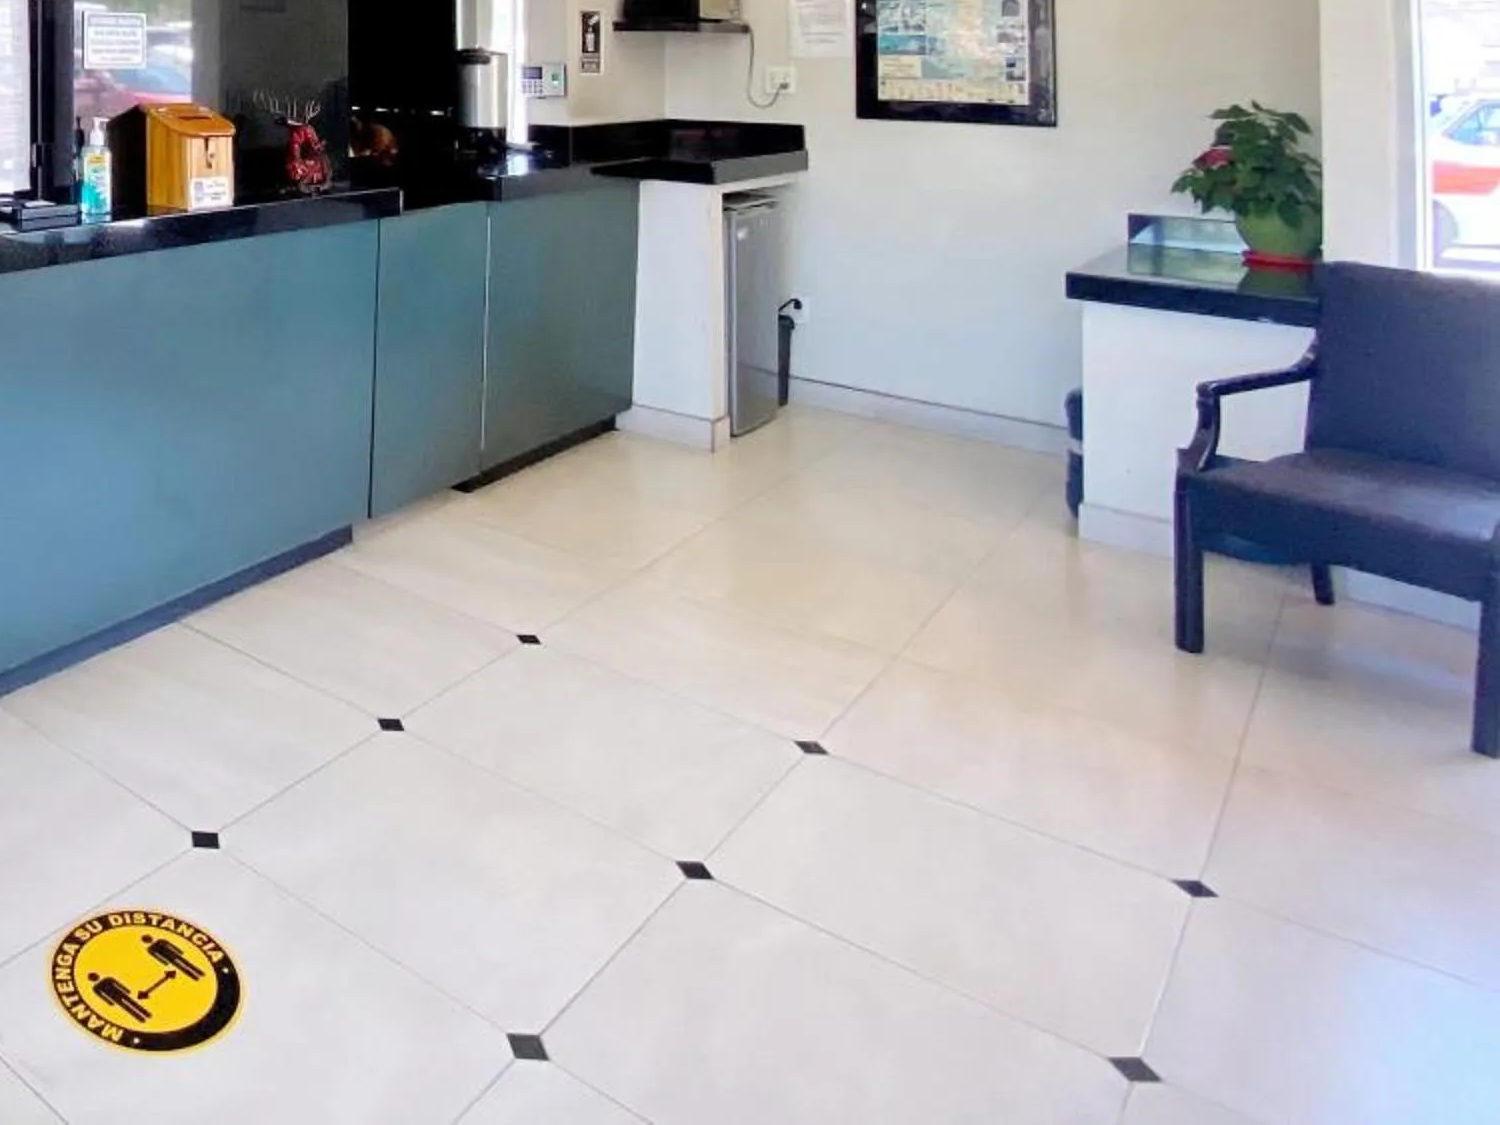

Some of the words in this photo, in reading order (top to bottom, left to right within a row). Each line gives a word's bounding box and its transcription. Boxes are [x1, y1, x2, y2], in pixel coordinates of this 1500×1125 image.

[75, 920, 104, 942] SU
[107, 912, 224, 963] DISTANCIA
[55, 944, 124, 1043] MANTENGA
